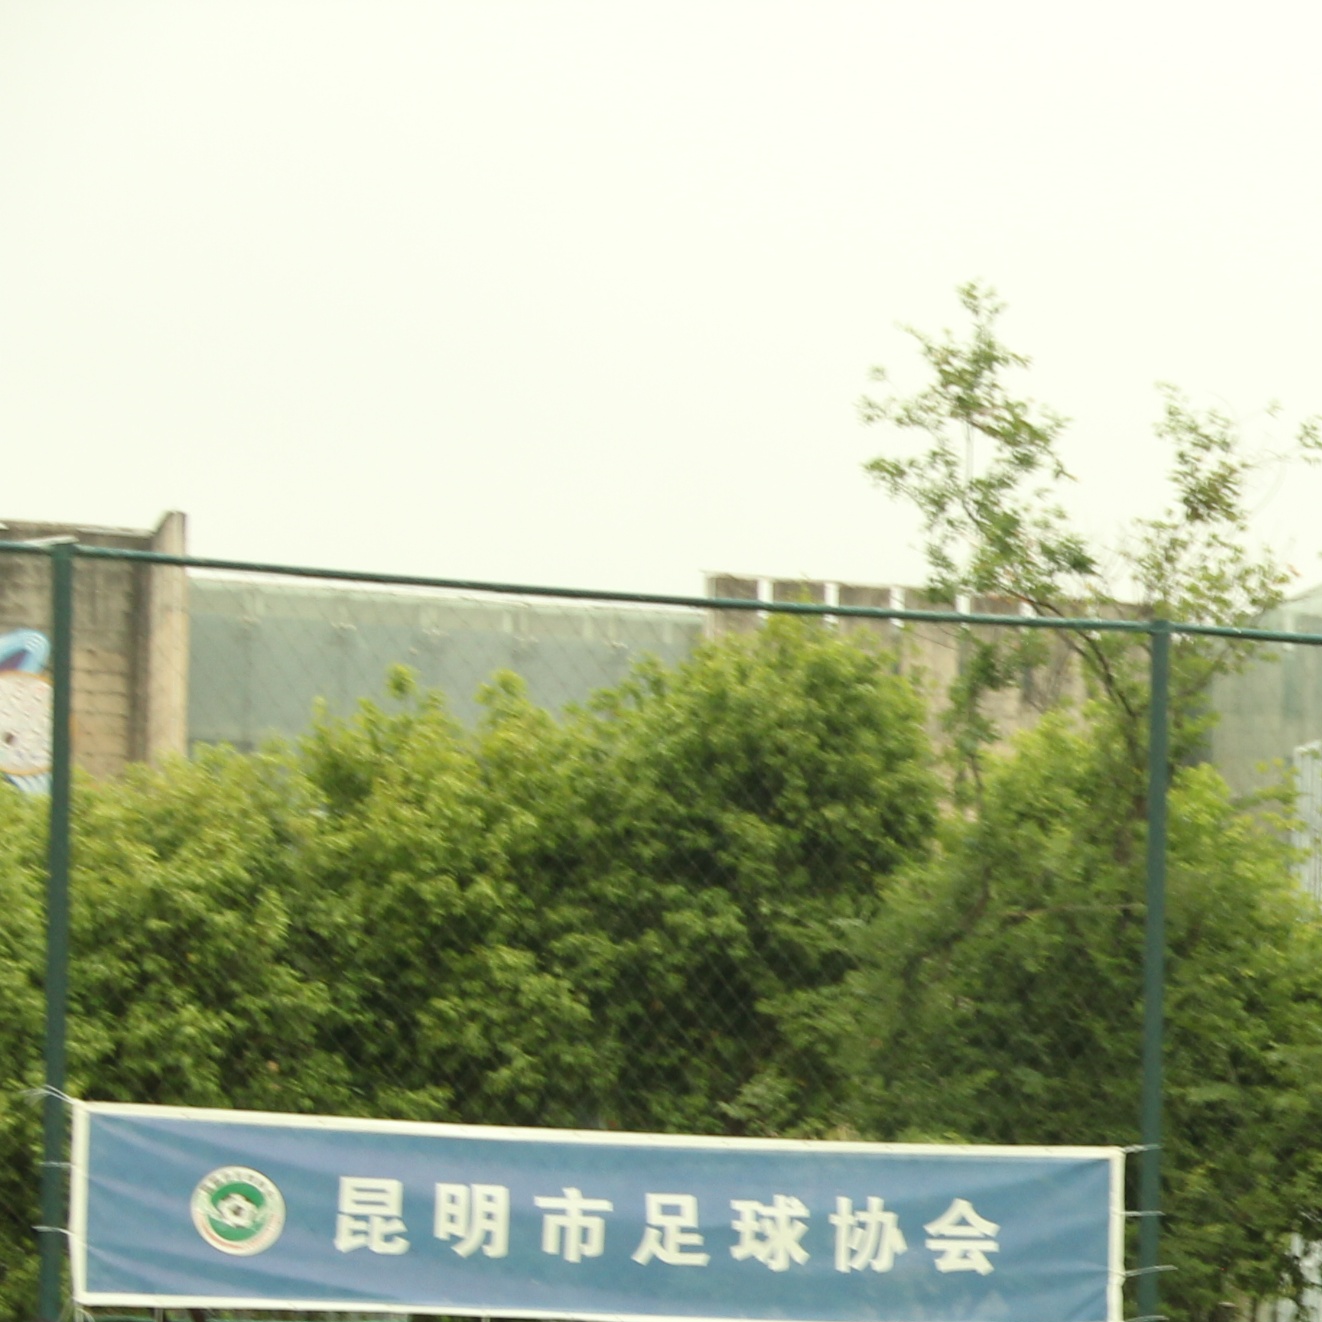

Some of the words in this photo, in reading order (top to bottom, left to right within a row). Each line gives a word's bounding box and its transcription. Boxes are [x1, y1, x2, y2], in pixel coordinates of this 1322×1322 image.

[333, 1174, 1001, 1276] 昆明市足球协会
